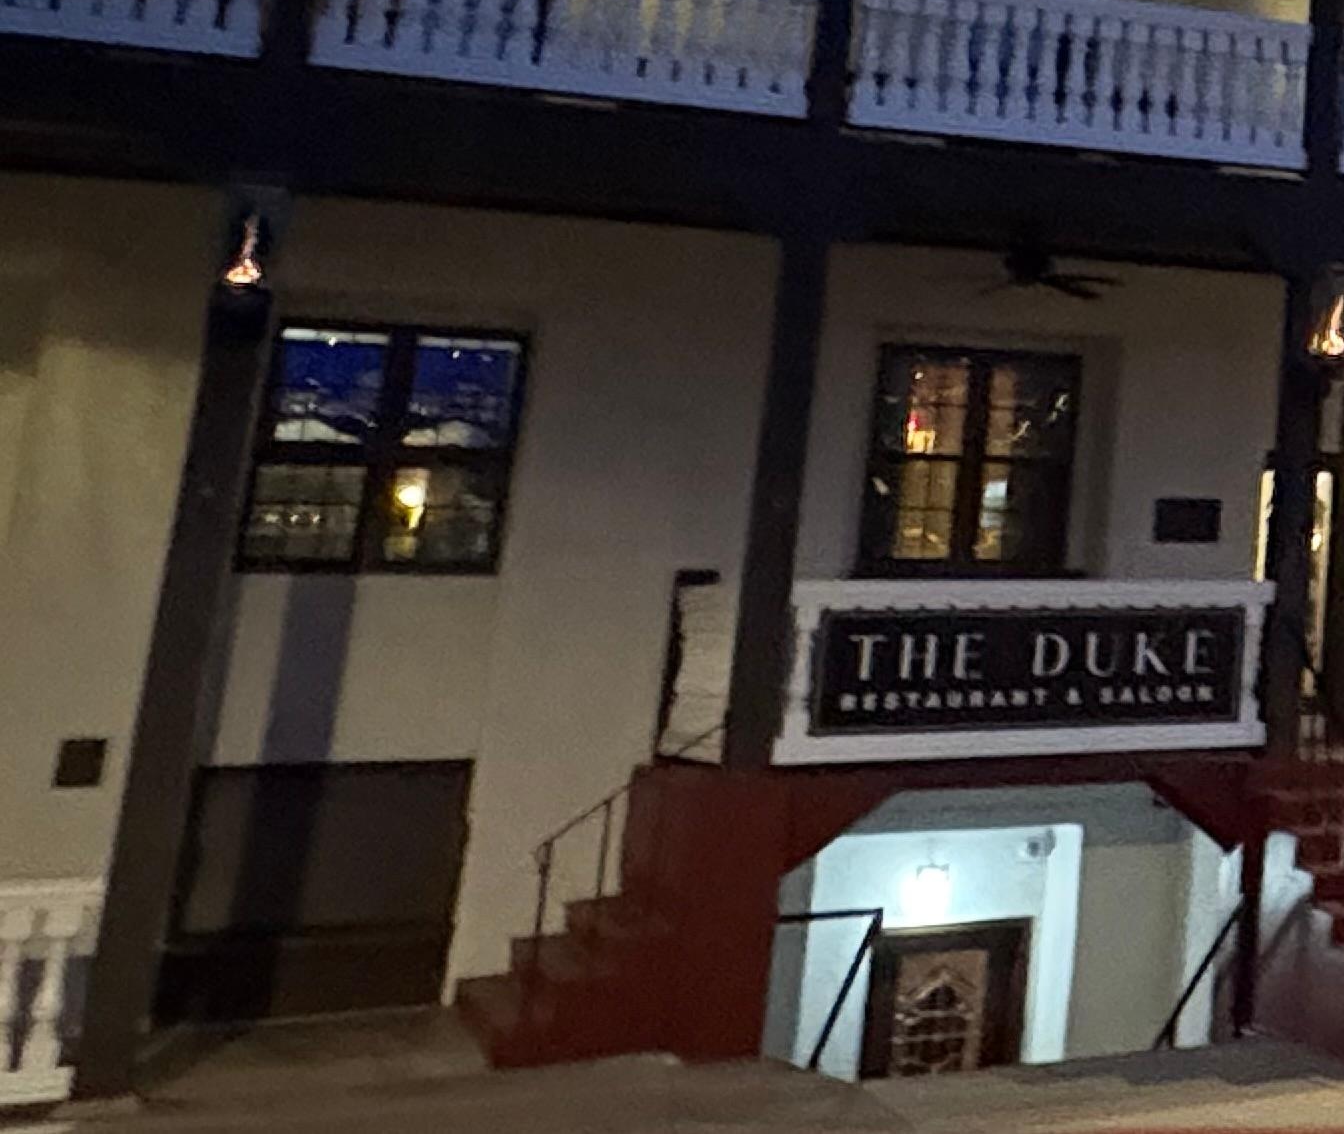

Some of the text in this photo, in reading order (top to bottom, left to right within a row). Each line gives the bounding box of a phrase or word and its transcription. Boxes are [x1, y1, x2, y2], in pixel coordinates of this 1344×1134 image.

[849, 629, 1215, 682] THE DUKE
[839, 685, 1214, 712] RESTAURANT & SALOON
